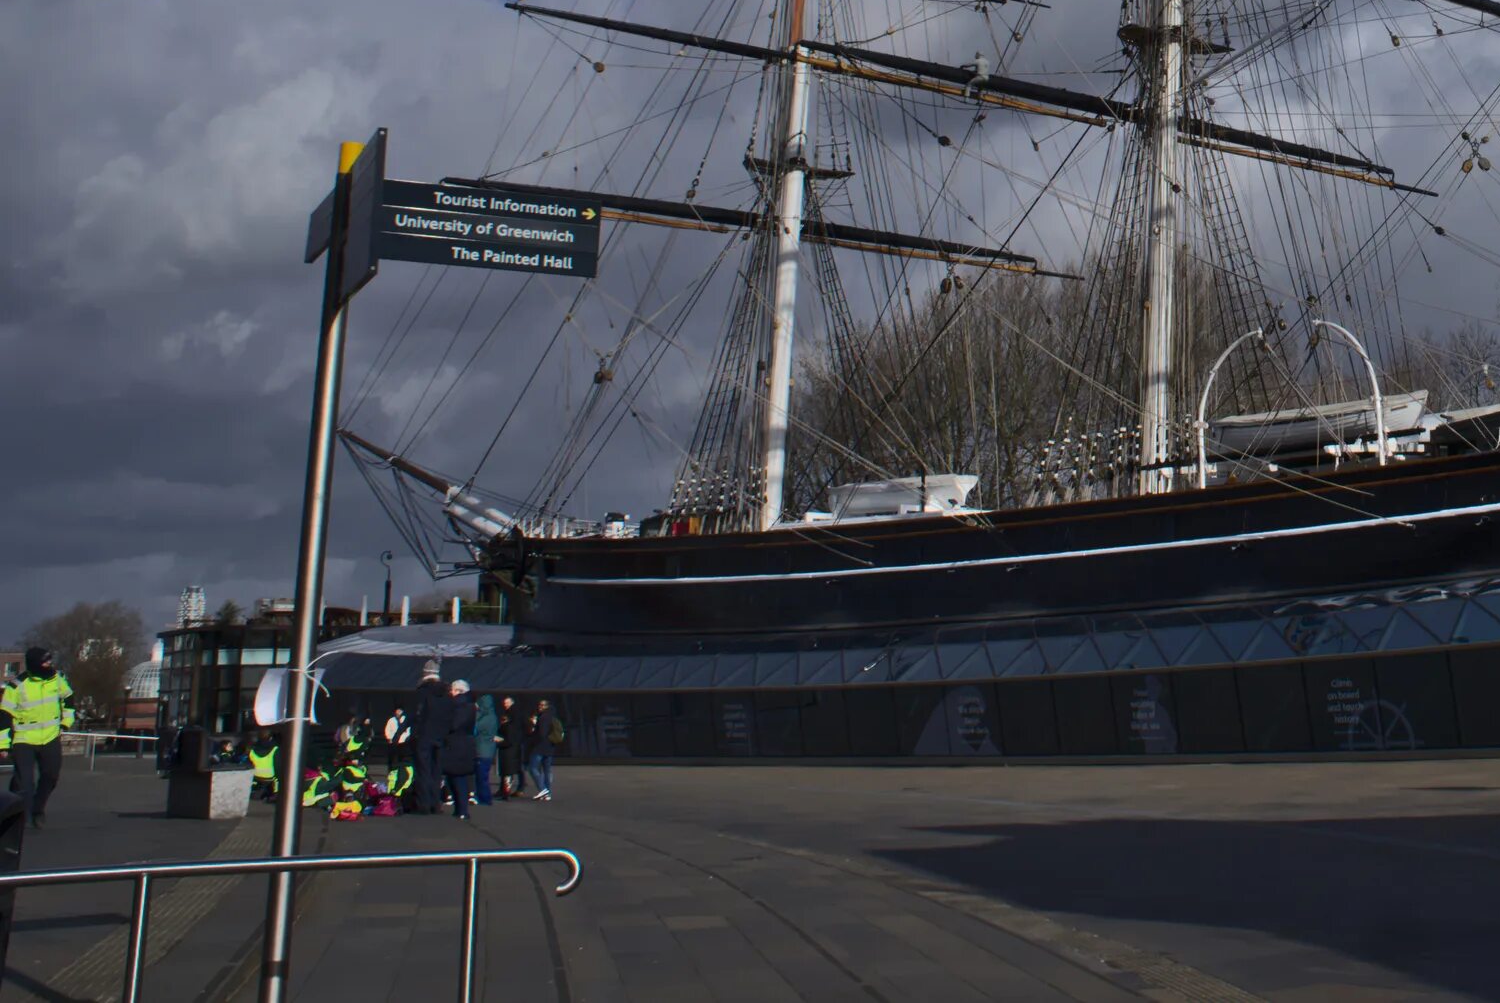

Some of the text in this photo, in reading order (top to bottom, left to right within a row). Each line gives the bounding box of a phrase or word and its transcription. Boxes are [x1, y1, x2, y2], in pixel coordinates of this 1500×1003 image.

[433, 190, 577, 218] Tourist Information
[395, 214, 575, 244] University of Greenwich
[451, 246, 574, 270] The Painted Hall
